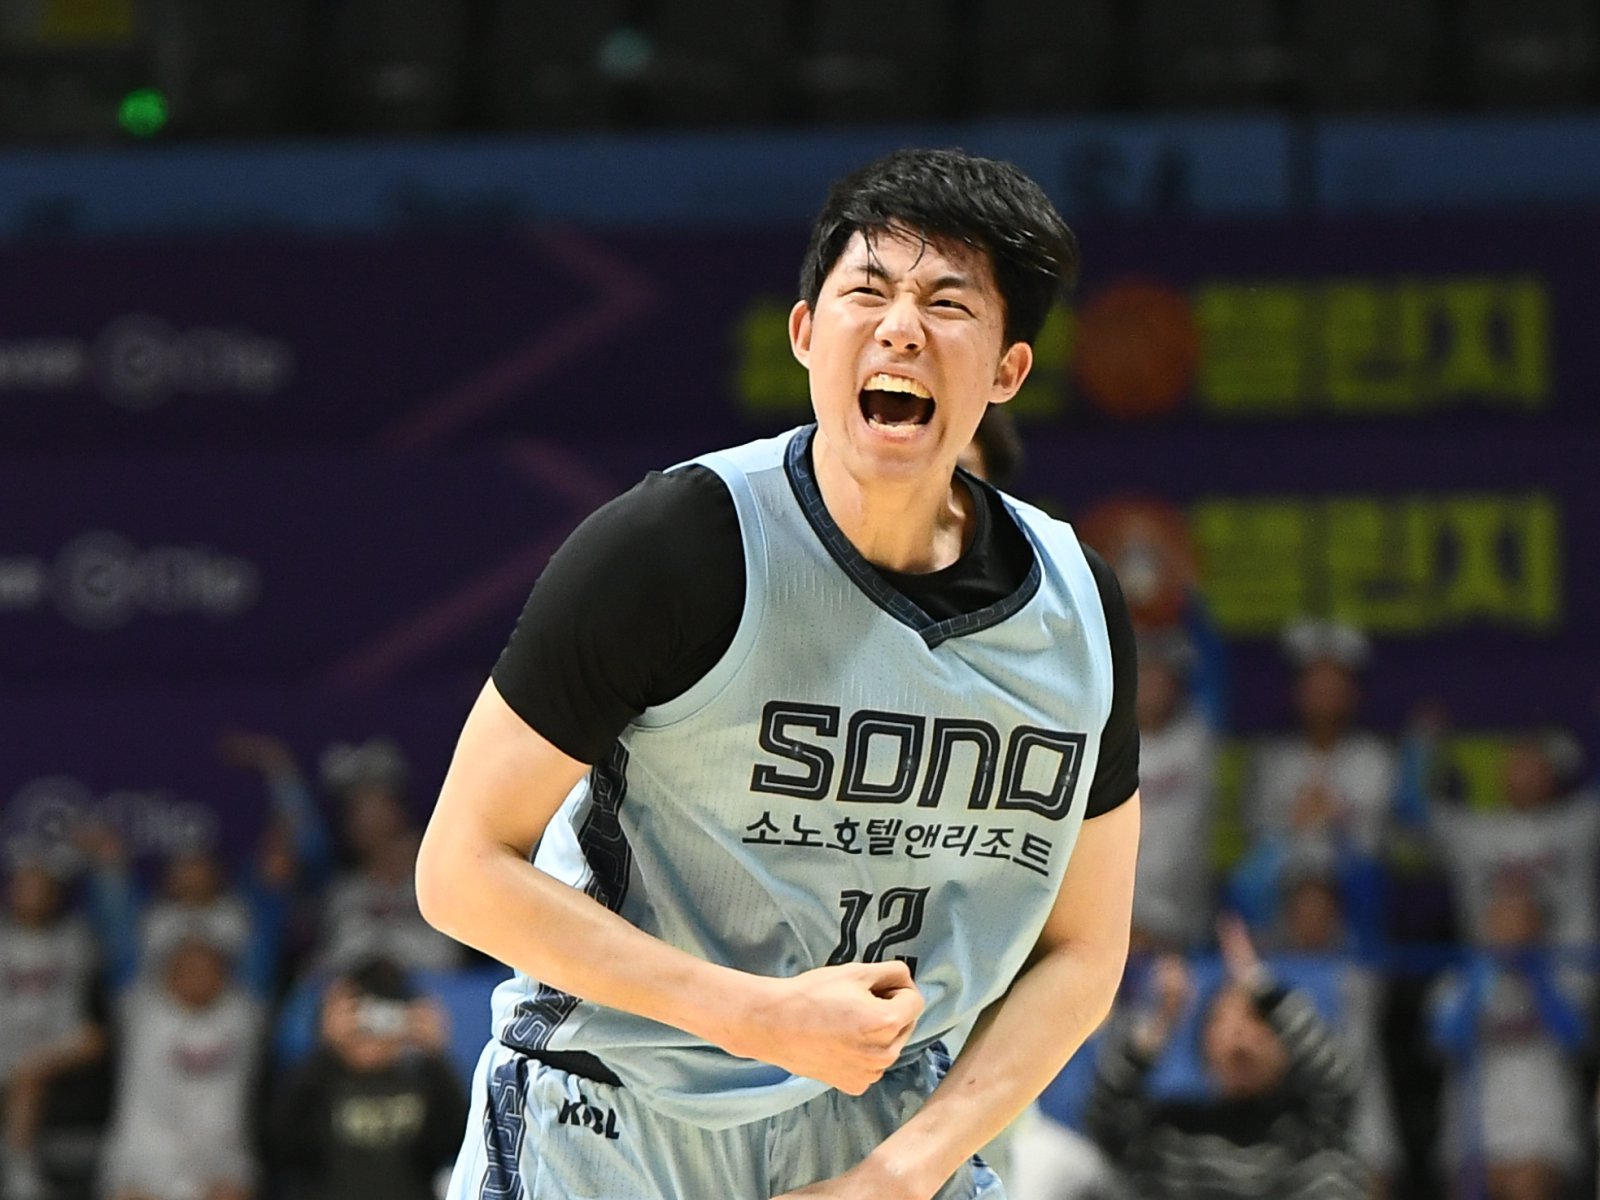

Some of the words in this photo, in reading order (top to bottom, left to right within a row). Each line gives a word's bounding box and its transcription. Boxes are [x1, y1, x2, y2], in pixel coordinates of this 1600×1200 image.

[742, 810, 1053, 878] 소노호텔앤리조트
[825, 885, 932, 980] 12
[558, 1094, 620, 1140] KBL
